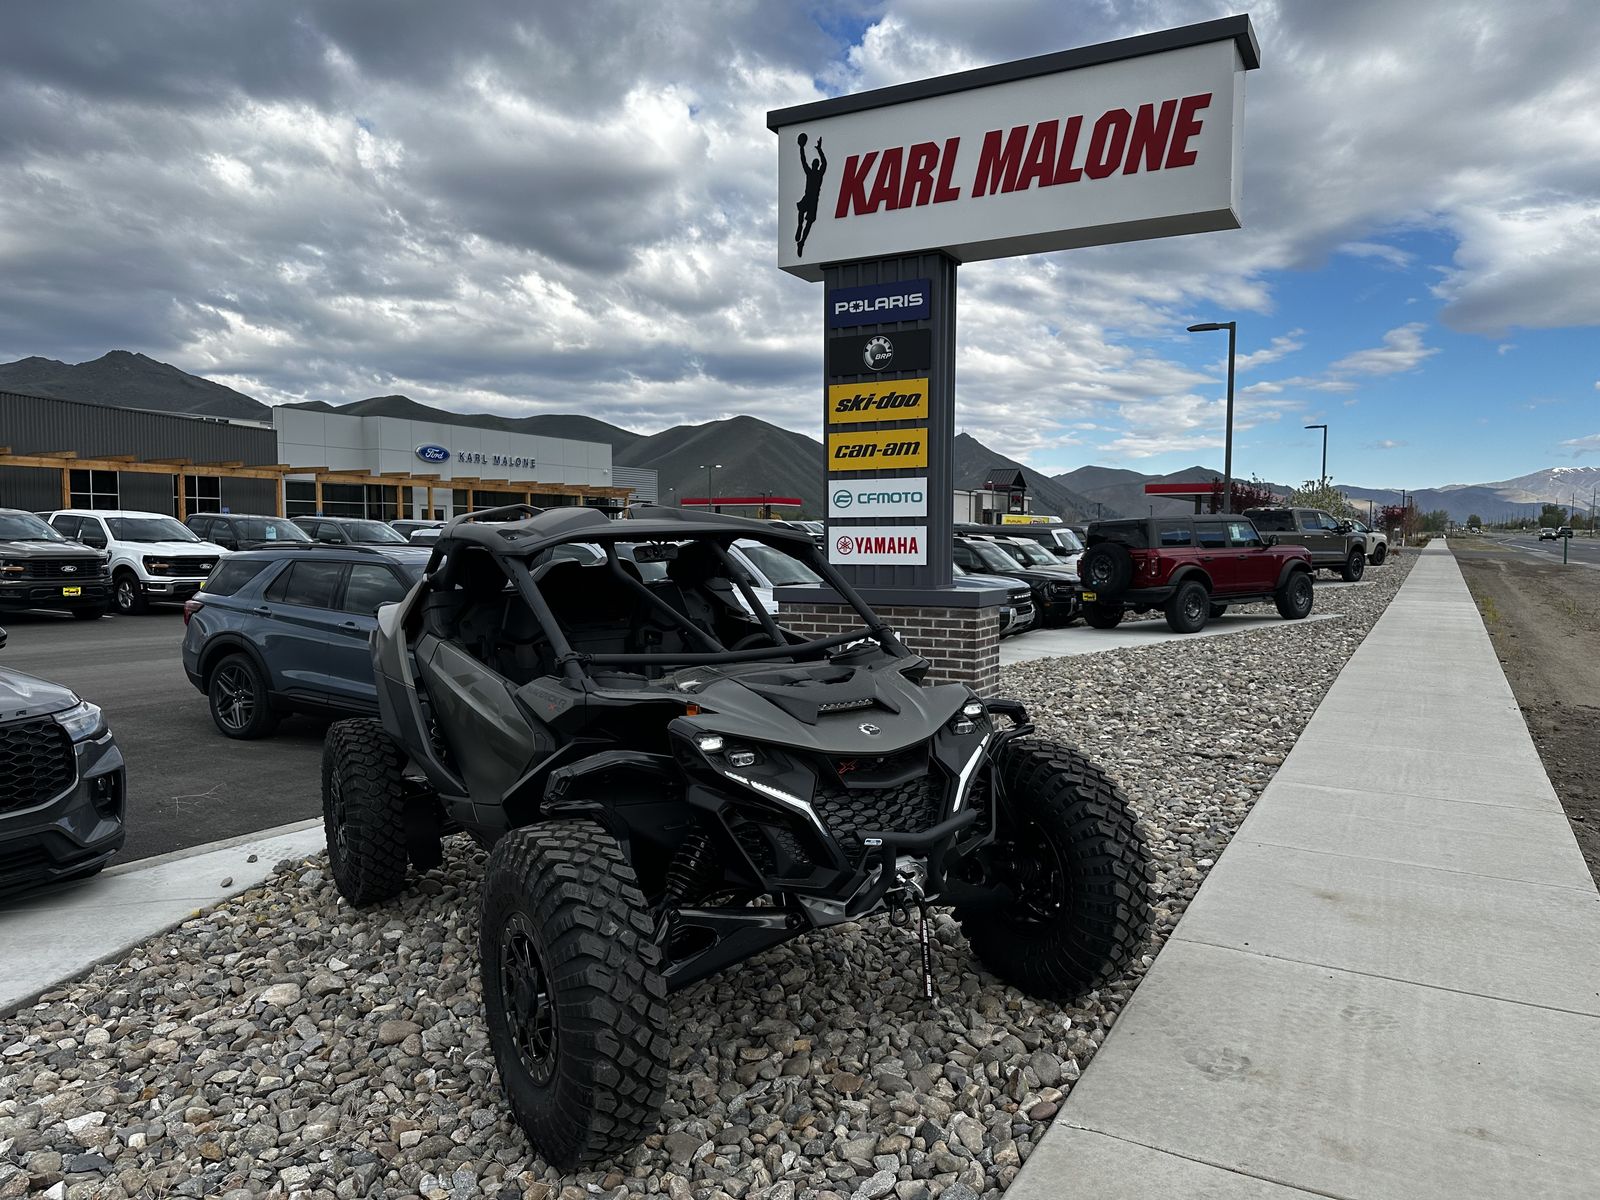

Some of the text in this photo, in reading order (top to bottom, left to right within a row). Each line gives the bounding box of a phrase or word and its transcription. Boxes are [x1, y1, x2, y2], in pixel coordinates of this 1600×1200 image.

[835, 92, 1212, 219] KARL MALONE
[835, 293, 924, 315] POLARIS
[875, 352, 892, 360] BRP
[835, 392, 922, 412] ski-doo
[425, 447, 537, 469] Ford KARL MALONE
[834, 441, 920, 459] can-am
[857, 491, 923, 505] CFMOTO
[855, 536, 919, 554] YAMAHA
